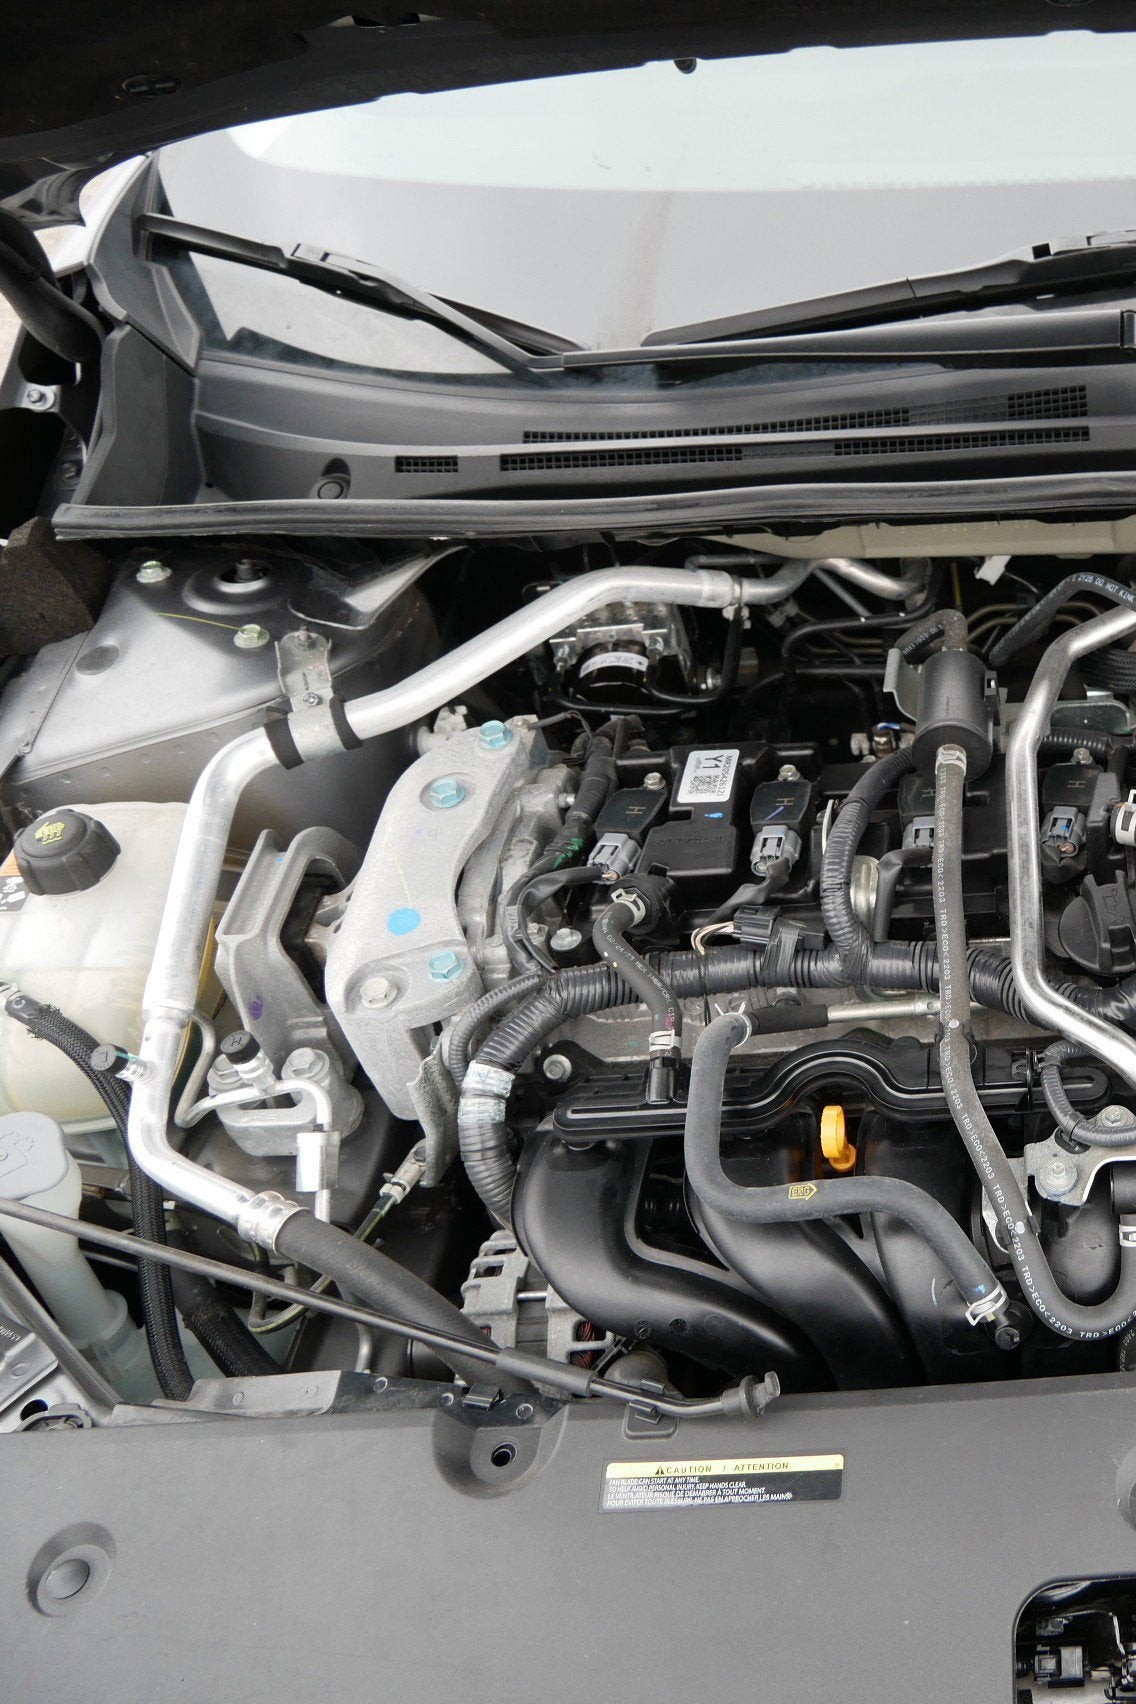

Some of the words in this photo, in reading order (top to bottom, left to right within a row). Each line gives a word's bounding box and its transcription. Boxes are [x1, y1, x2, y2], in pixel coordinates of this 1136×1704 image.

[1105, 582, 1120, 593] NOT
[1119, 589, 1135, 604] KINK
[702, 754, 724, 769] Y1
[791, 1185, 810, 1197] ENG
[992, 1183, 1026, 1261] TRD>ECO<2203
[1021, 1266, 1073, 1335] TRD>ECO<2203
[666, 1465, 712, 1475] CAUTION
[733, 1462, 789, 1472] ATTENTION
